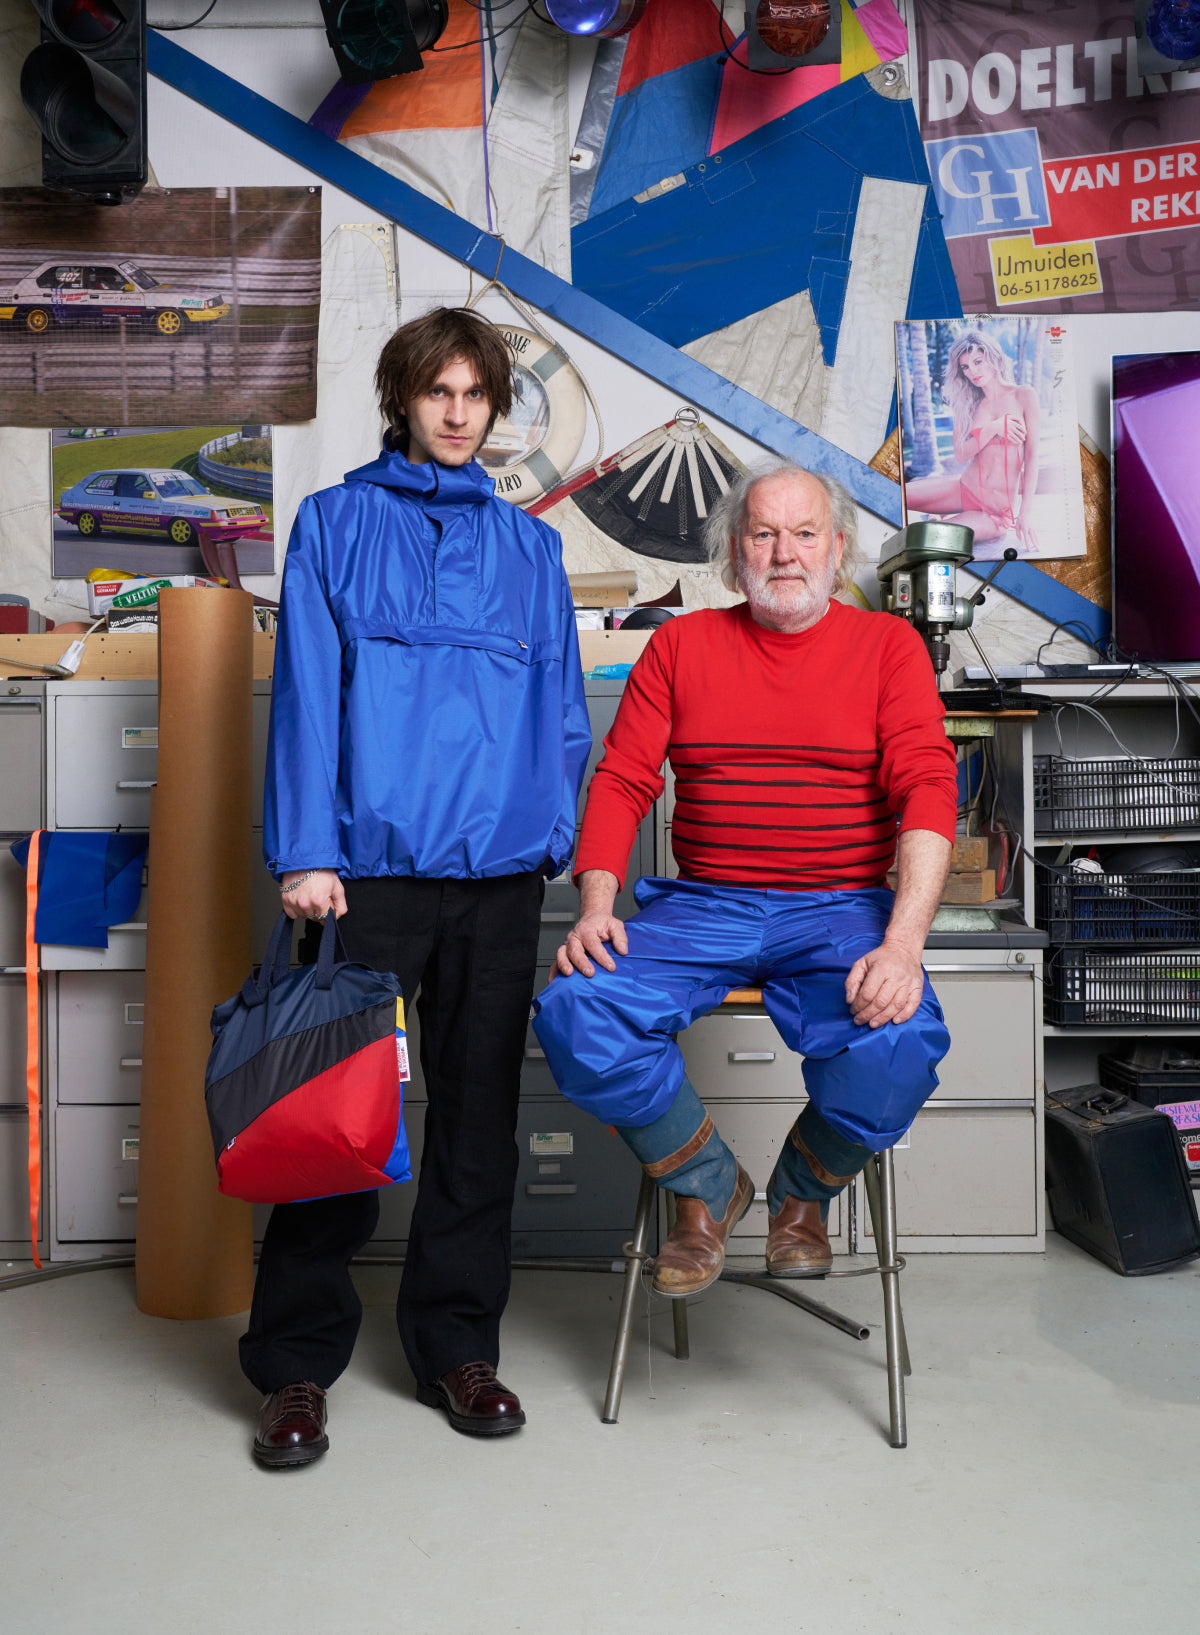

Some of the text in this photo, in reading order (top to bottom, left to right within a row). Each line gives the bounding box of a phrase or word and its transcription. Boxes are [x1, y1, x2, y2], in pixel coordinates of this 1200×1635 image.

[1047, 152, 1198, 193] VAN DER
[938, 144, 1040, 225] GH
[998, 248, 1094, 277] IJmuiden
[60, 271, 81, 282] 407
[1000, 273, 1097, 296] 06-51178625
[500, 330, 531, 354] OME
[97, 479, 114, 488] 407
[125, 584, 161, 604] VELTINS
